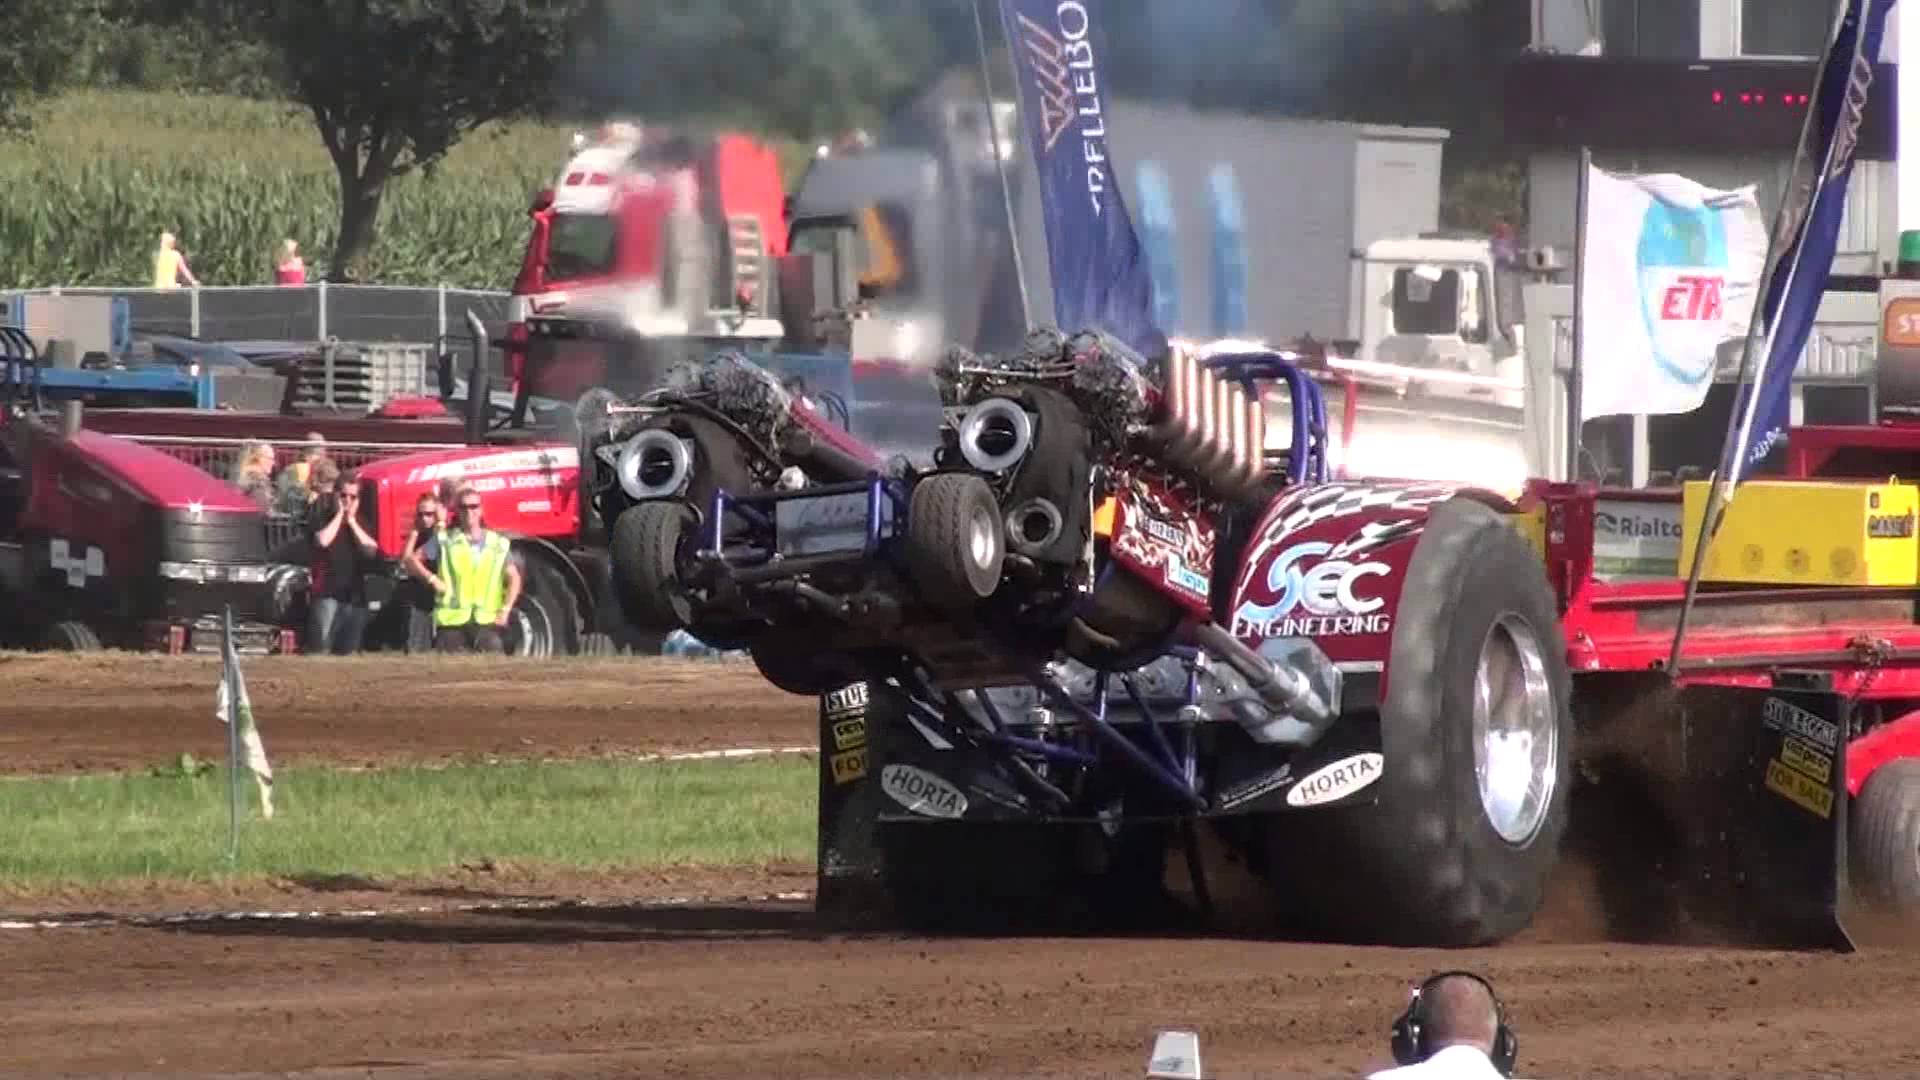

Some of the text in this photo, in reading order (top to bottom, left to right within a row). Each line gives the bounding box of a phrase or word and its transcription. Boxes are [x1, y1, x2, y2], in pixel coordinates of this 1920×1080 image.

[1661, 274, 1724, 321] ETA
[1619, 515, 1683, 537] Rialto
[1231, 613, 1391, 638] ENGINEERING
[890, 767, 959, 813] HORTA
[1300, 757, 1375, 800] HORTA
